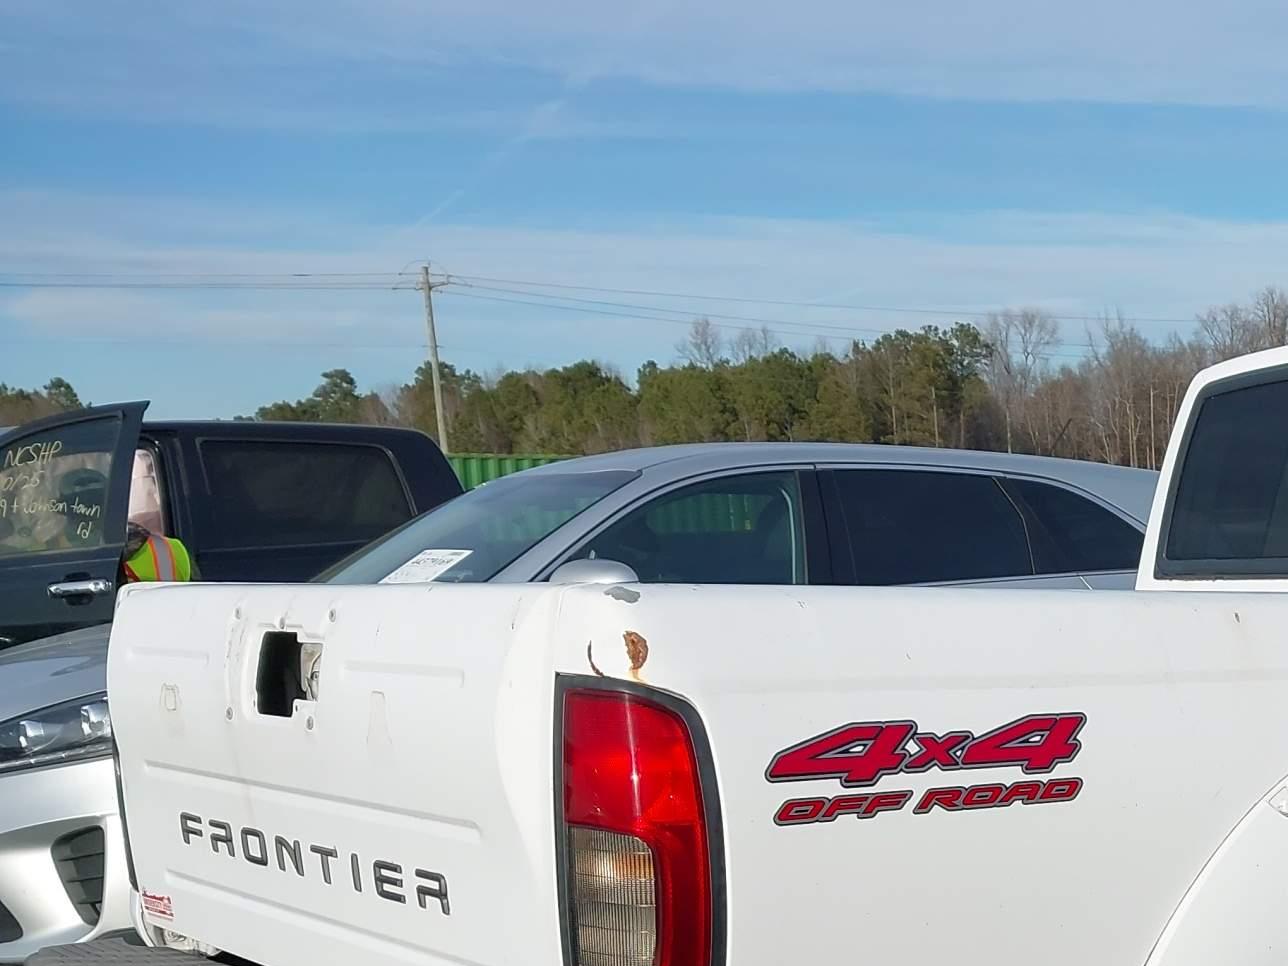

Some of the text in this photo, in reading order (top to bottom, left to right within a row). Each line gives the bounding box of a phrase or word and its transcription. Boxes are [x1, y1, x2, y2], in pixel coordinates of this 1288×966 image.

[4, 440, 63, 468] NCSHP
[765, 712, 1087, 788] 4x4
[773, 777, 1083, 826] OFF ROAD
[180, 811, 451, 916] FRONTIER
